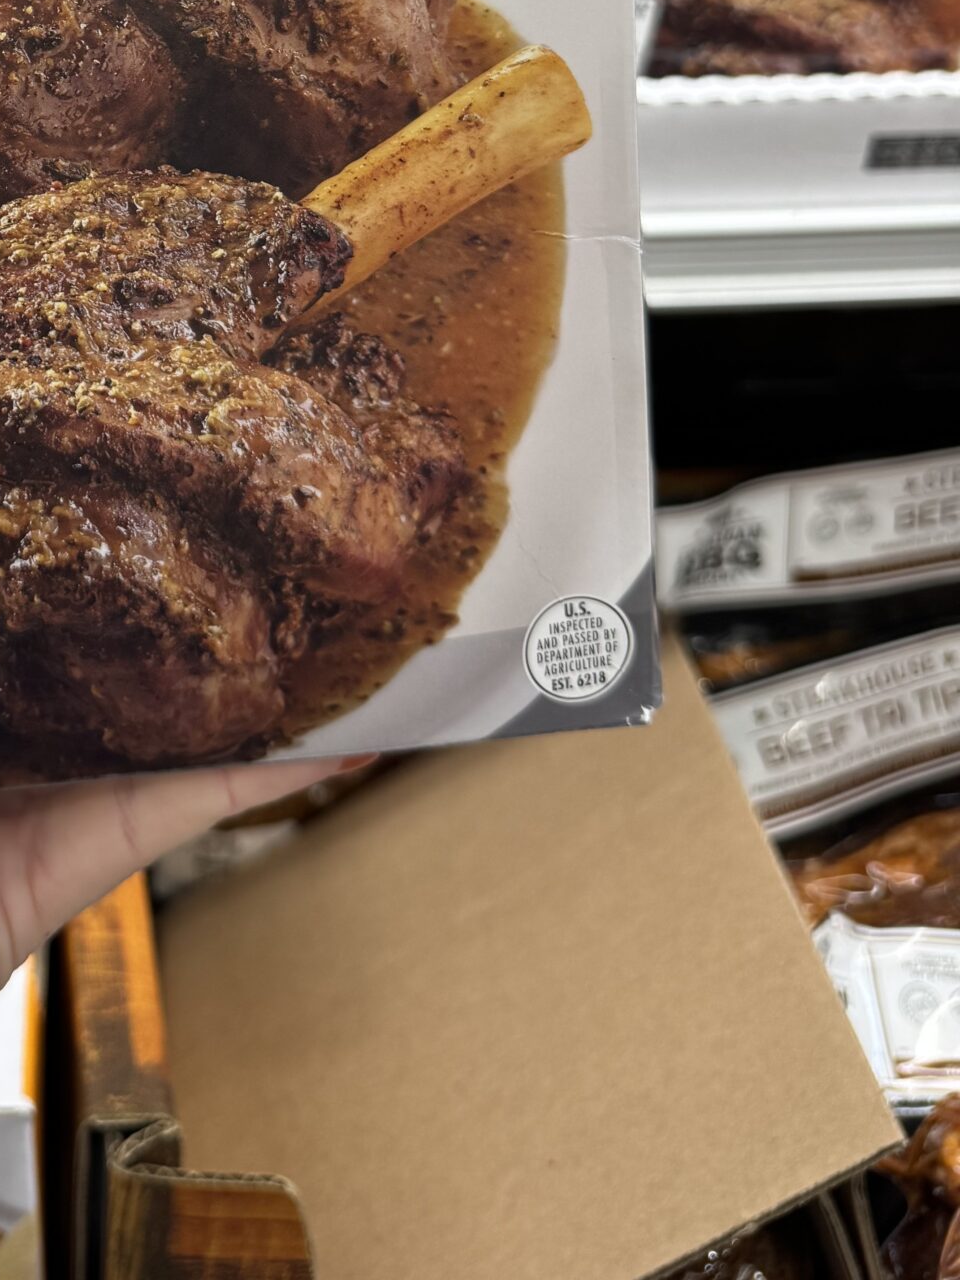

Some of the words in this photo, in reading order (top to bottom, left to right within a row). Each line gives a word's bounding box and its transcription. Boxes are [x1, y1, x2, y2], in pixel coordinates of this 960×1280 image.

[563, 600, 590, 617] U.S.
[548, 616, 602, 634] INSPECTED
[536, 636, 557, 650] AND
[562, 630, 598, 646] PASSED
[603, 627, 615, 639] BY
[536, 643, 599, 663] DEPARTMENT
[605, 640, 617, 653] OF
[544, 654, 611, 676] AGRICULTURE
[551, 676, 572, 691] EST.
[576, 670, 606, 687] 6218
